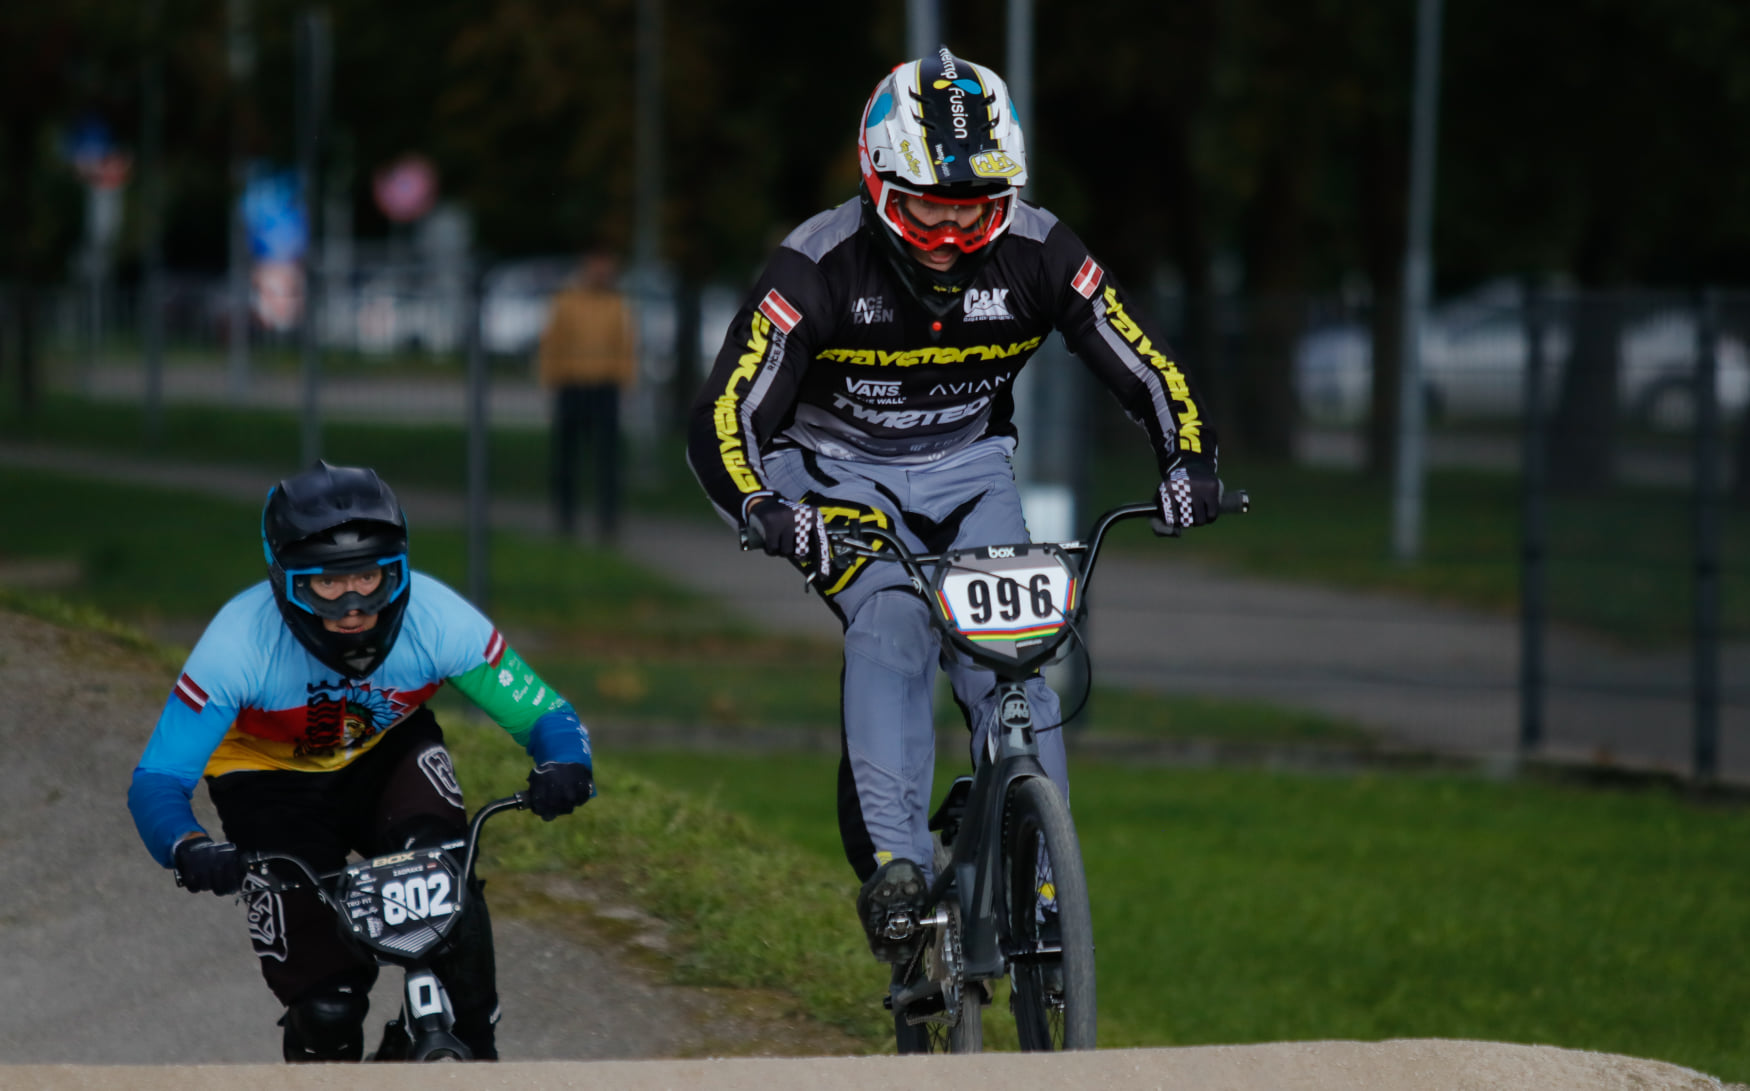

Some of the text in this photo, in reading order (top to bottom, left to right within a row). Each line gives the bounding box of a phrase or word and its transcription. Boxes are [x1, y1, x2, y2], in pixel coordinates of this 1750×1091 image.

[948, 86, 969, 139] Fusion
[963, 287, 1009, 315] C&K
[845, 376, 902, 397] VANS
[929, 371, 1011, 396] AVIAN
[987, 545, 1016, 559] box
[967, 574, 1053, 625] 996
[372, 851, 416, 868] BOX
[381, 872, 454, 926] 802
